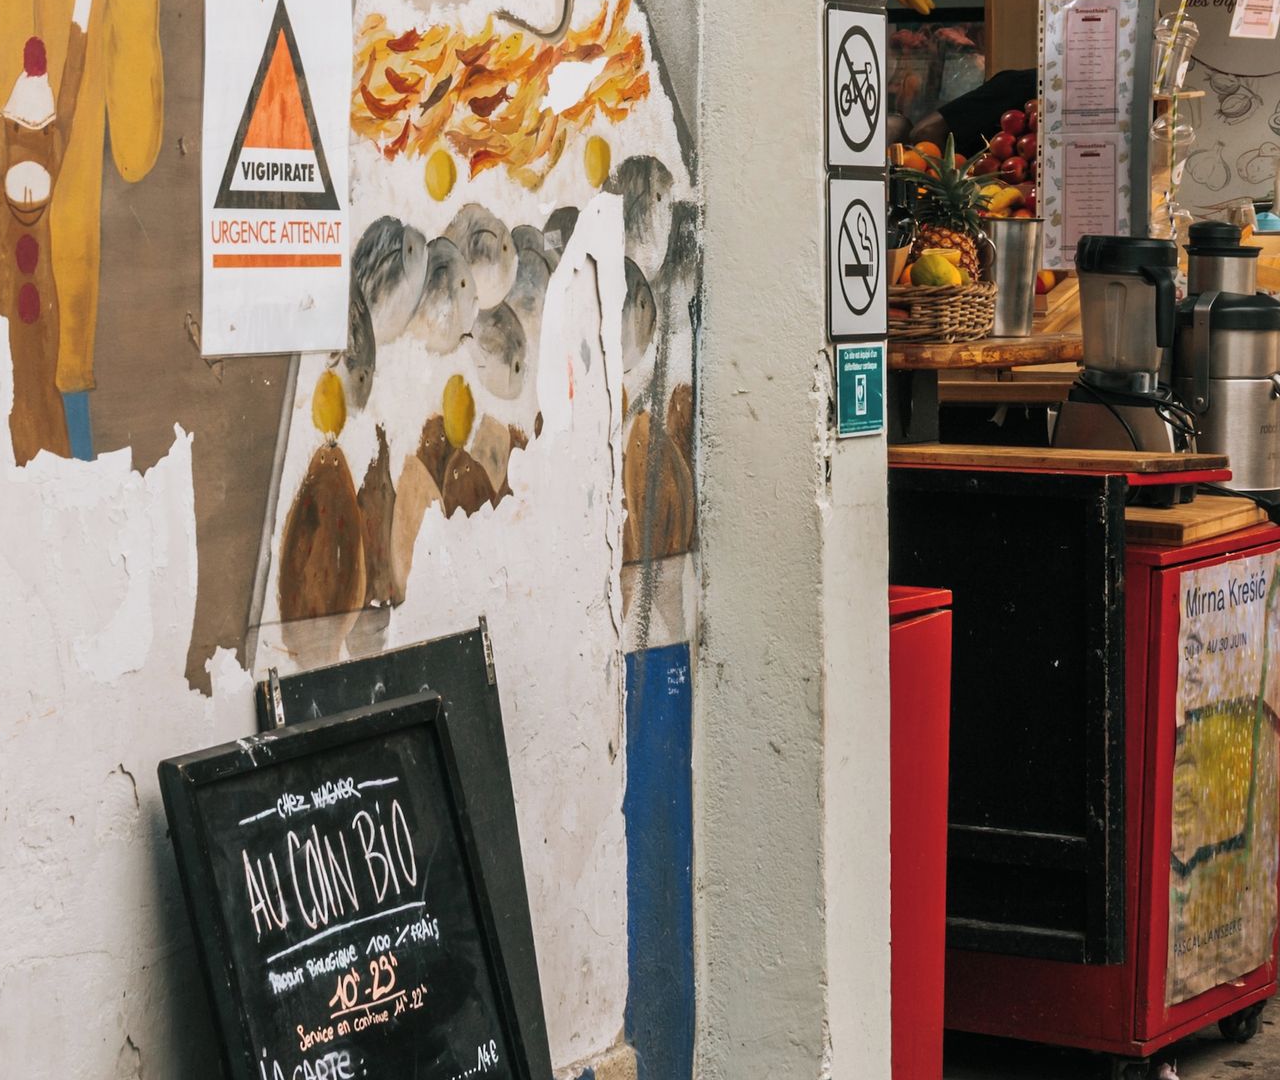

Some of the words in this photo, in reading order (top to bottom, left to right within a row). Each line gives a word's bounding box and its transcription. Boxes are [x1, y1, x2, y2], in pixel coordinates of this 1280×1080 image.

[241, 161, 315, 183] VIGIPIRATE
[211, 220, 278, 245] URGENCE
[279, 221, 342, 245] ATTENTAT
[1186, 586, 1225, 618] Mirna
[1228, 570, 1266, 608] Krešić
[1207, 638, 1218, 655] AU
[1230, 631, 1247, 650] JUIN
[242, 848, 287, 933] AU
[365, 933, 391, 955] 100
[1174, 934, 1201, 957] PASCAL
[296, 1023, 334, 1052] Service
[337, 1019, 352, 1036] en
